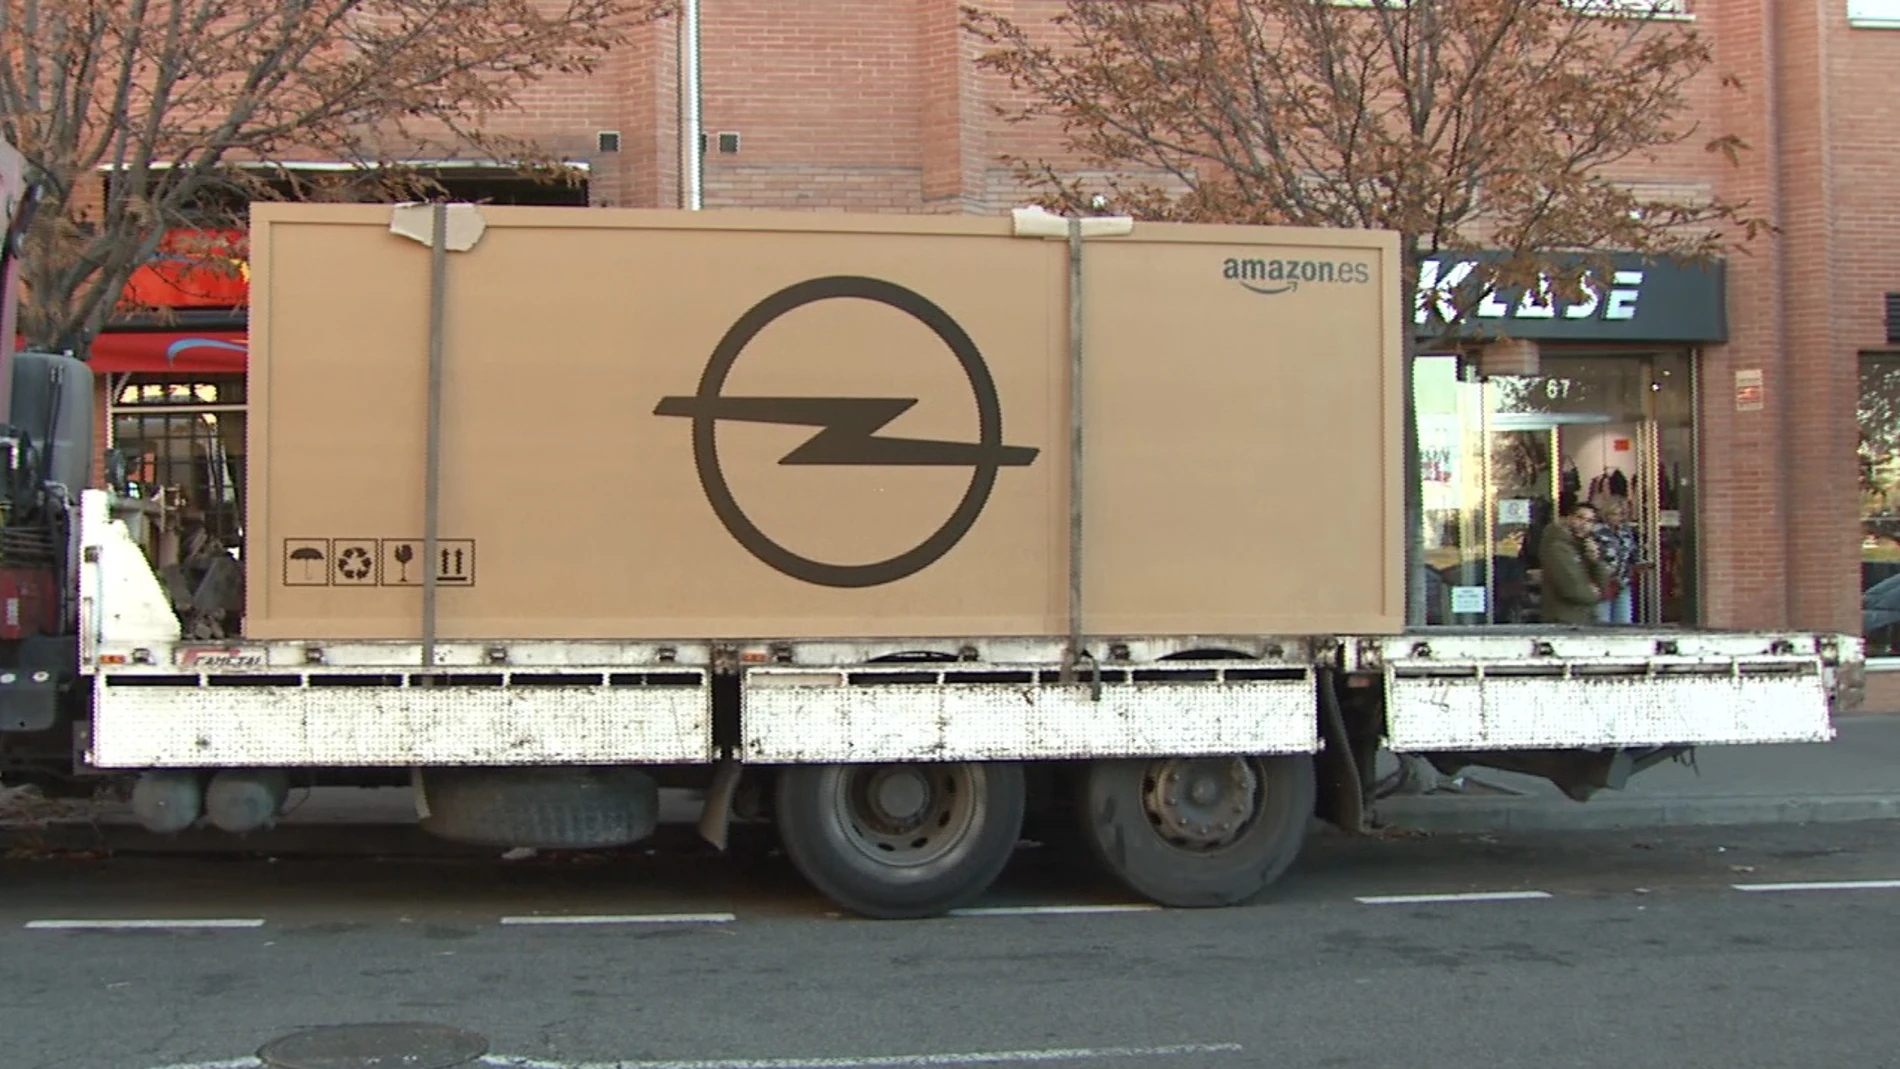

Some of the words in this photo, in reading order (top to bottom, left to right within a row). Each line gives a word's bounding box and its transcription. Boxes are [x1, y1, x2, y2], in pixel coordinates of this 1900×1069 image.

[1223, 257, 1370, 284] amazon.es
[1413, 259, 1644, 325] KLASE
[1546, 378, 1571, 399] 67
